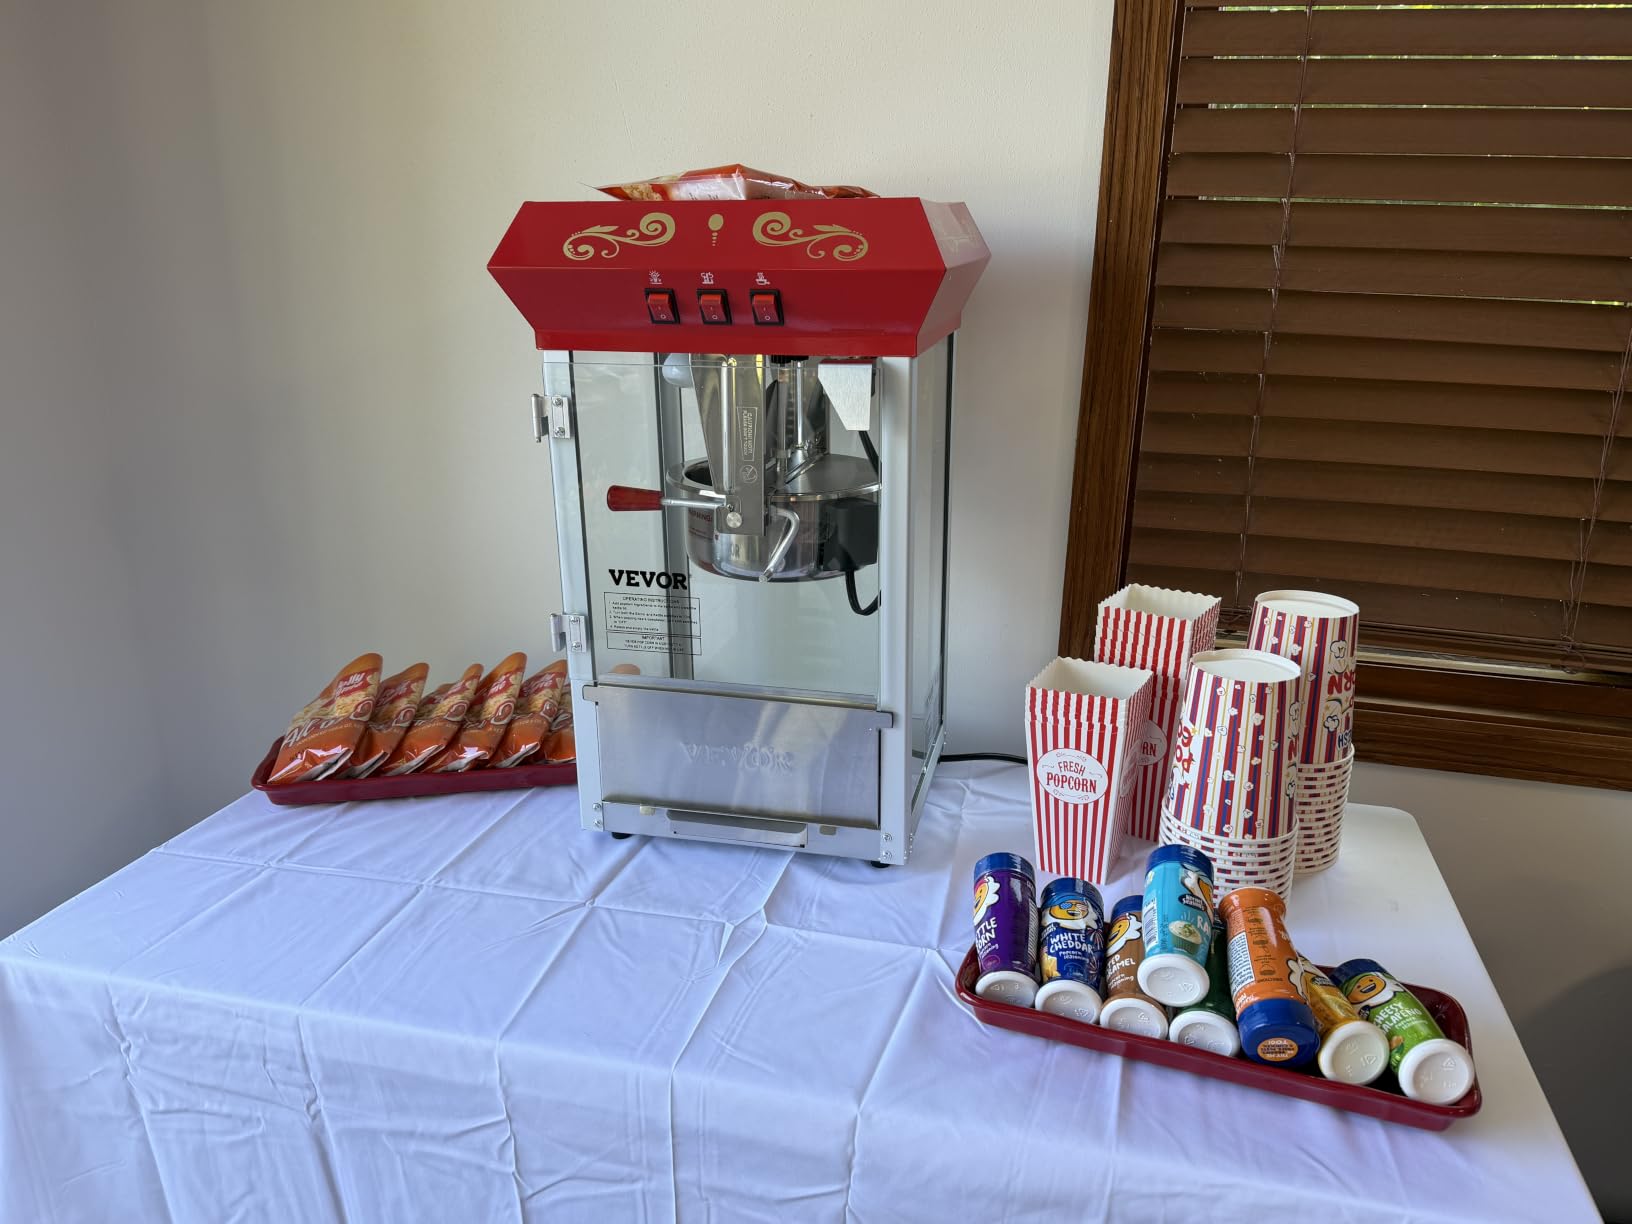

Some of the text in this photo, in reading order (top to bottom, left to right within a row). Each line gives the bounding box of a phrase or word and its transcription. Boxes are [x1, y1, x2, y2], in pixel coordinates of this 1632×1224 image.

[608, 568, 688, 590] VEVOR
[1058, 761, 1086, 777] FRESH
[1046, 772, 1097, 794] POPCORN
[976, 917, 998, 939] TTLE
[1049, 941, 1094, 955] CHEDDAR
[1050, 932, 1086, 945] WHITE
